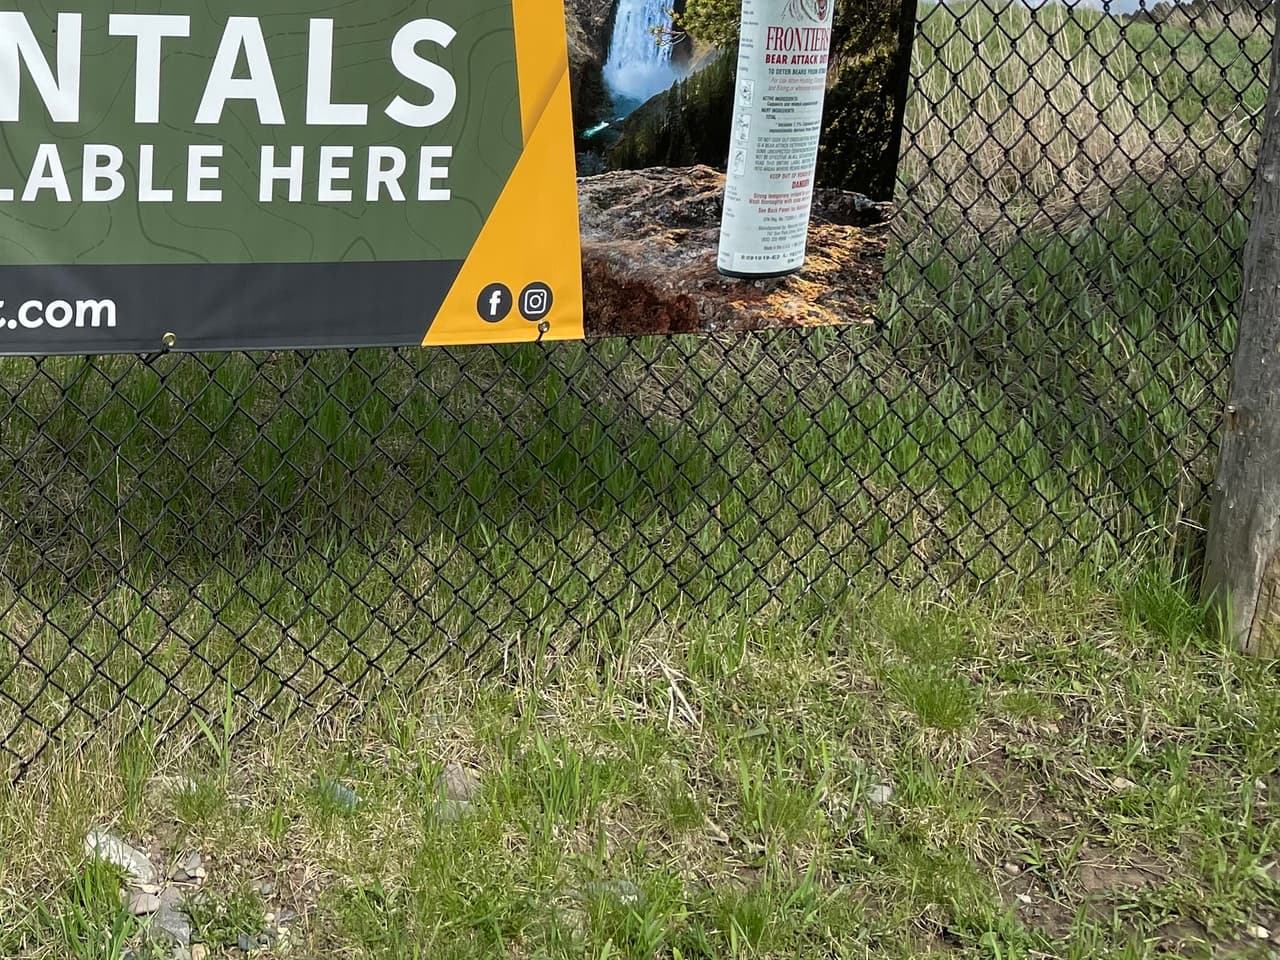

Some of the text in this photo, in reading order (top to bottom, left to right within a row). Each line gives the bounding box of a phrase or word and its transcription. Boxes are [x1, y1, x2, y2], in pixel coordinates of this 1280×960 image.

[765, 53, 788, 65] BEAR
[790, 54, 818, 65] ATTACK
[258, 144, 454, 203] HERE
